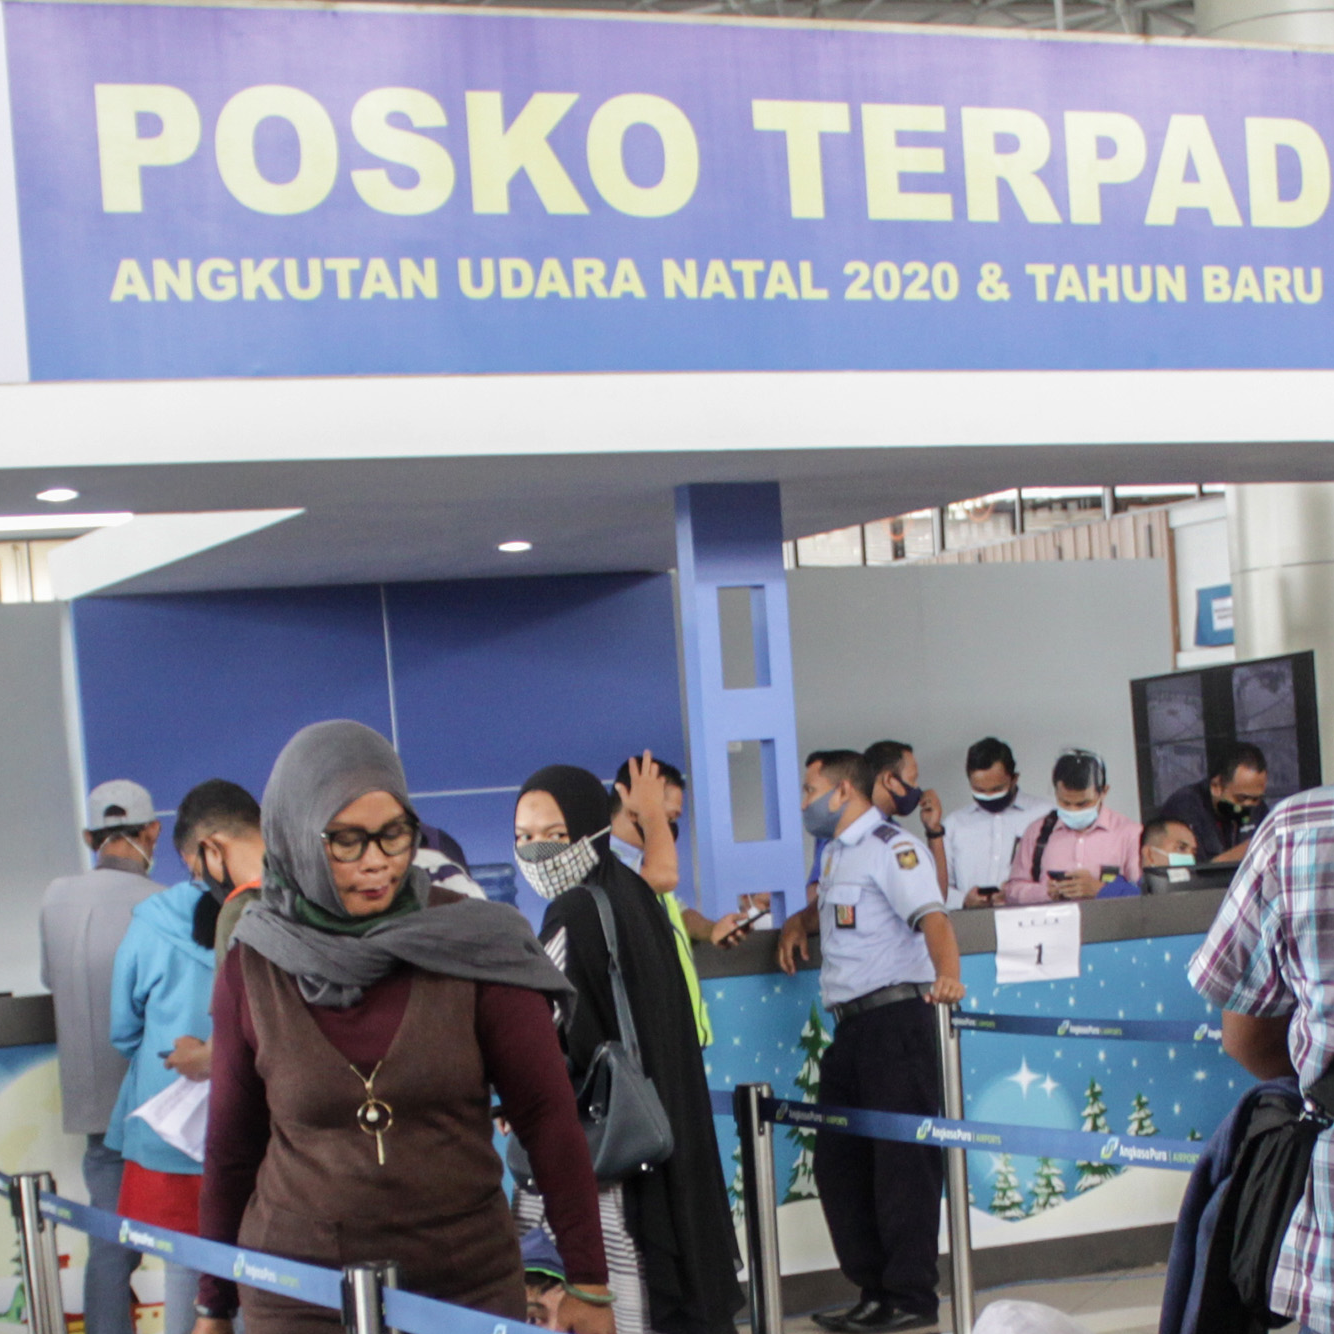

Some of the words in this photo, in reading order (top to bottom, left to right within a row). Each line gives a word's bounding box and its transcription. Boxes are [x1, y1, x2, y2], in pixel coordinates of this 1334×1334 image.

[94, 84, 699, 218] POSKO
[110, 258, 437, 302] ANGKUTAN
[458, 258, 646, 300] UDARA
[662, 259, 828, 300] NATAL
[843, 261, 959, 300] 2020
[976, 263, 1011, 302] &
[1026, 263, 1186, 303] TAHUN
[1202, 265, 1323, 303] BARU
[1035, 943, 1043, 965] 1
